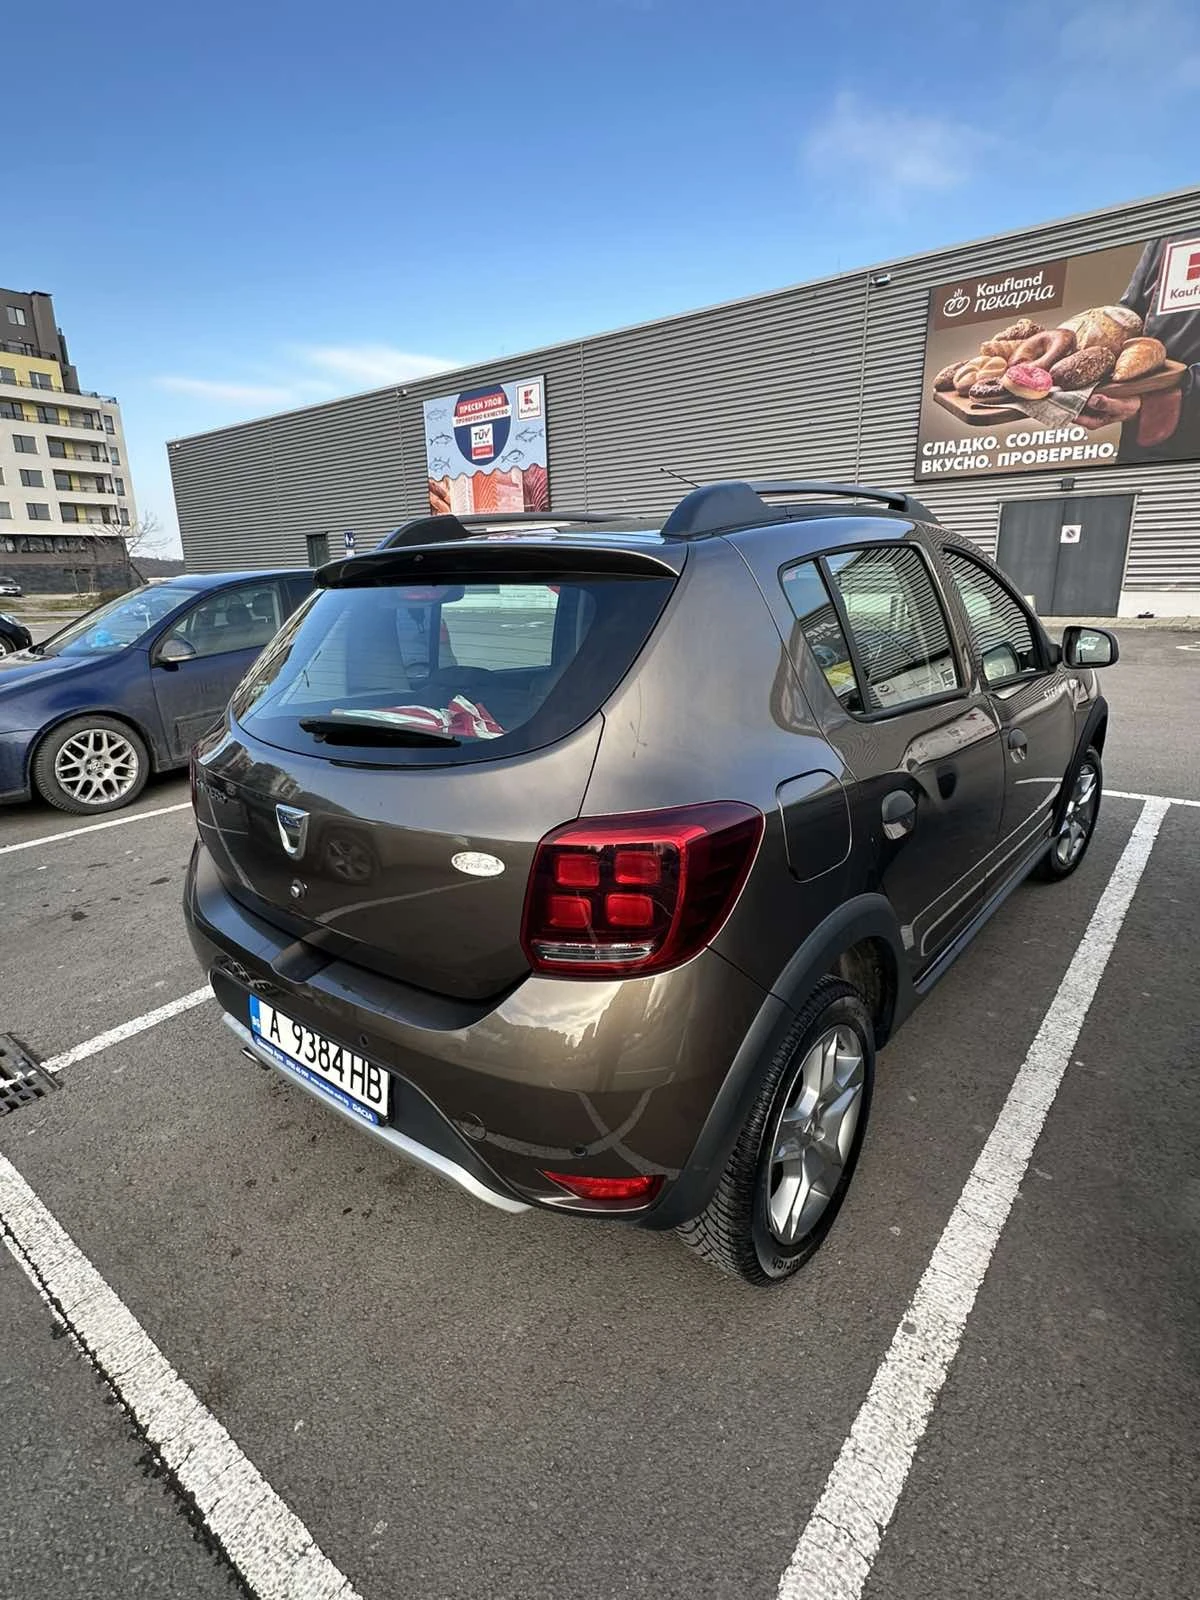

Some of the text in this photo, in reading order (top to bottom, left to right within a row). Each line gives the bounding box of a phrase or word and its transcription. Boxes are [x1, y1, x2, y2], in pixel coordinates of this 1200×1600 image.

[976, 270, 1044, 297] Kaufland
[1170, 285, 1200, 299] Kauf
[974, 284, 1056, 313] пекарна
[473, 427, 491, 441] TÜV
[922, 426, 1089, 456] СЛАДКО. СОЛЕНО.
[921, 443, 1119, 474] ВКУСНО. ПРОВЕРЕНО.
[270, 1008, 281, 1043] A
[352, 1103, 374, 1122] DACIA
